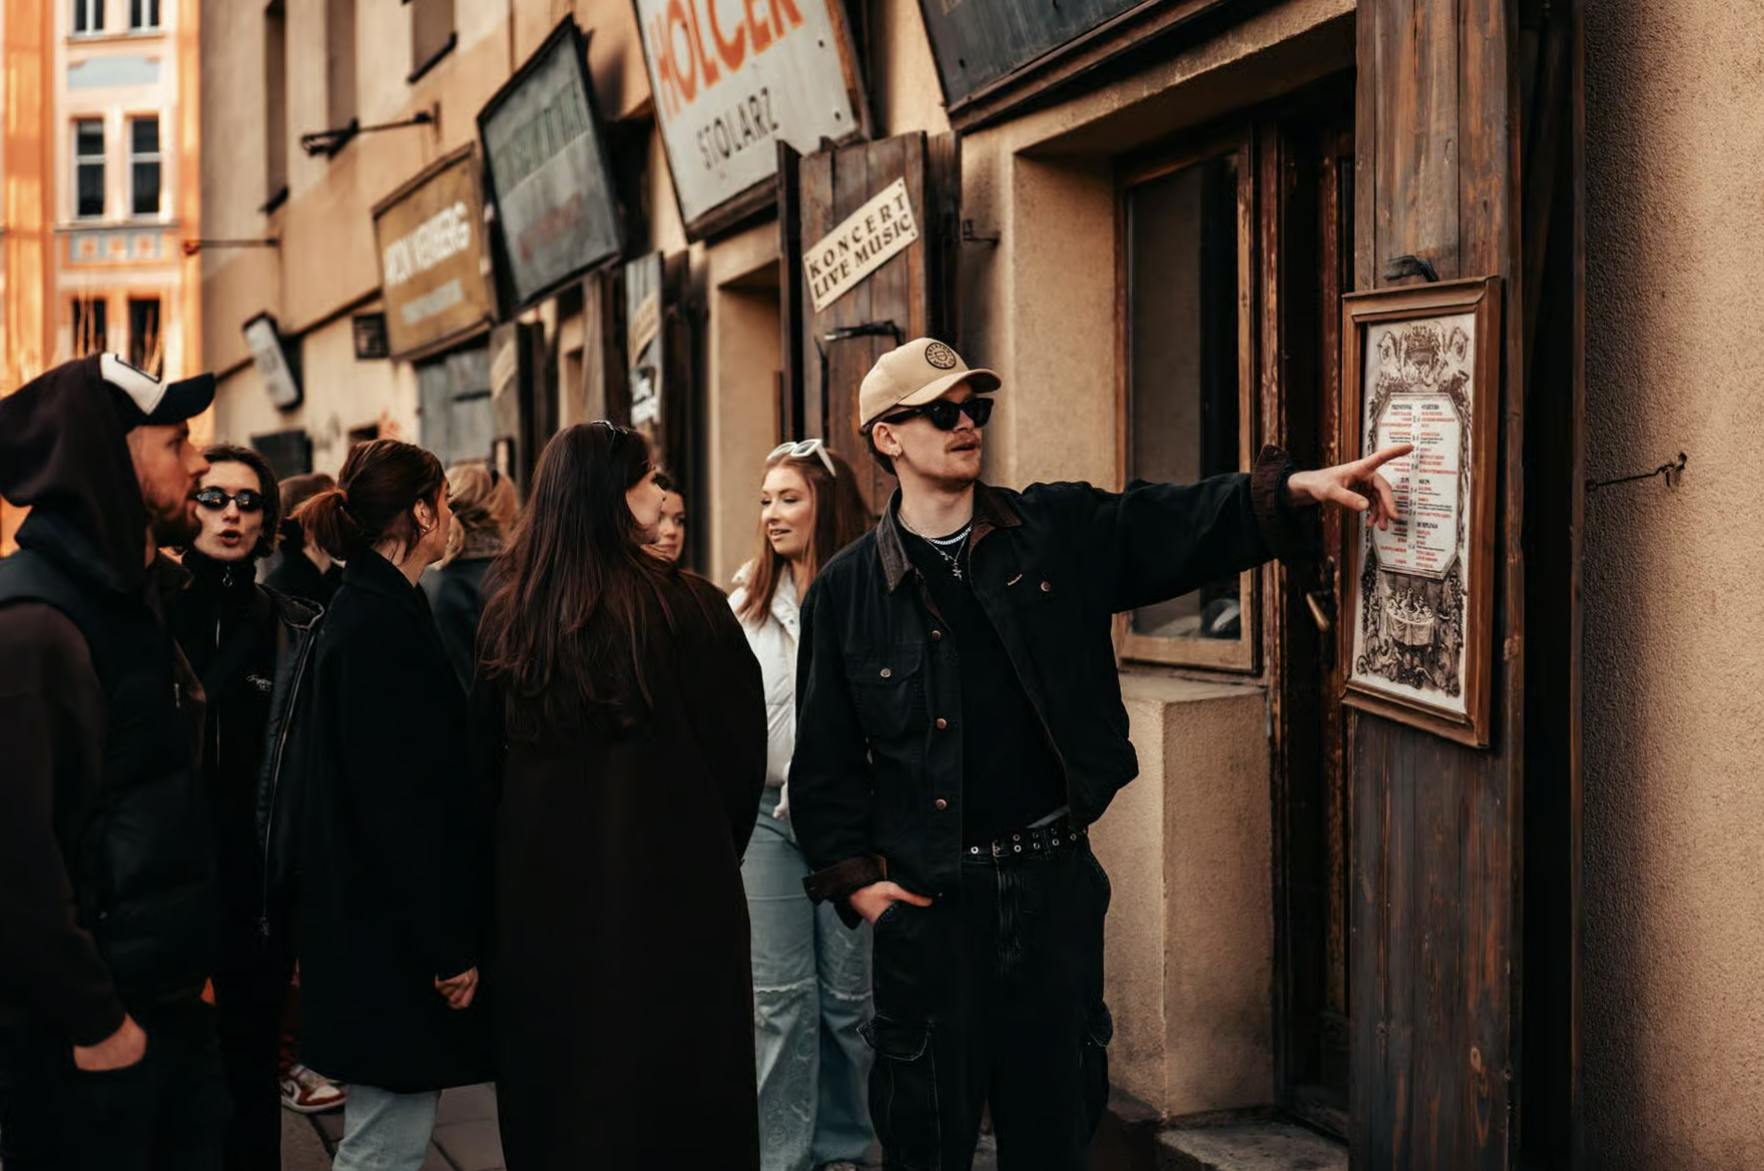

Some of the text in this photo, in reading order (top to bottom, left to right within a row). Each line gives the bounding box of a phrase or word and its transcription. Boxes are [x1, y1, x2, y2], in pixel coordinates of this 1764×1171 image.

[697, 85, 779, 171] STOLARZ
[808, 192, 905, 280] KONCERT
[813, 212, 912, 299] LIVE MUSIC
